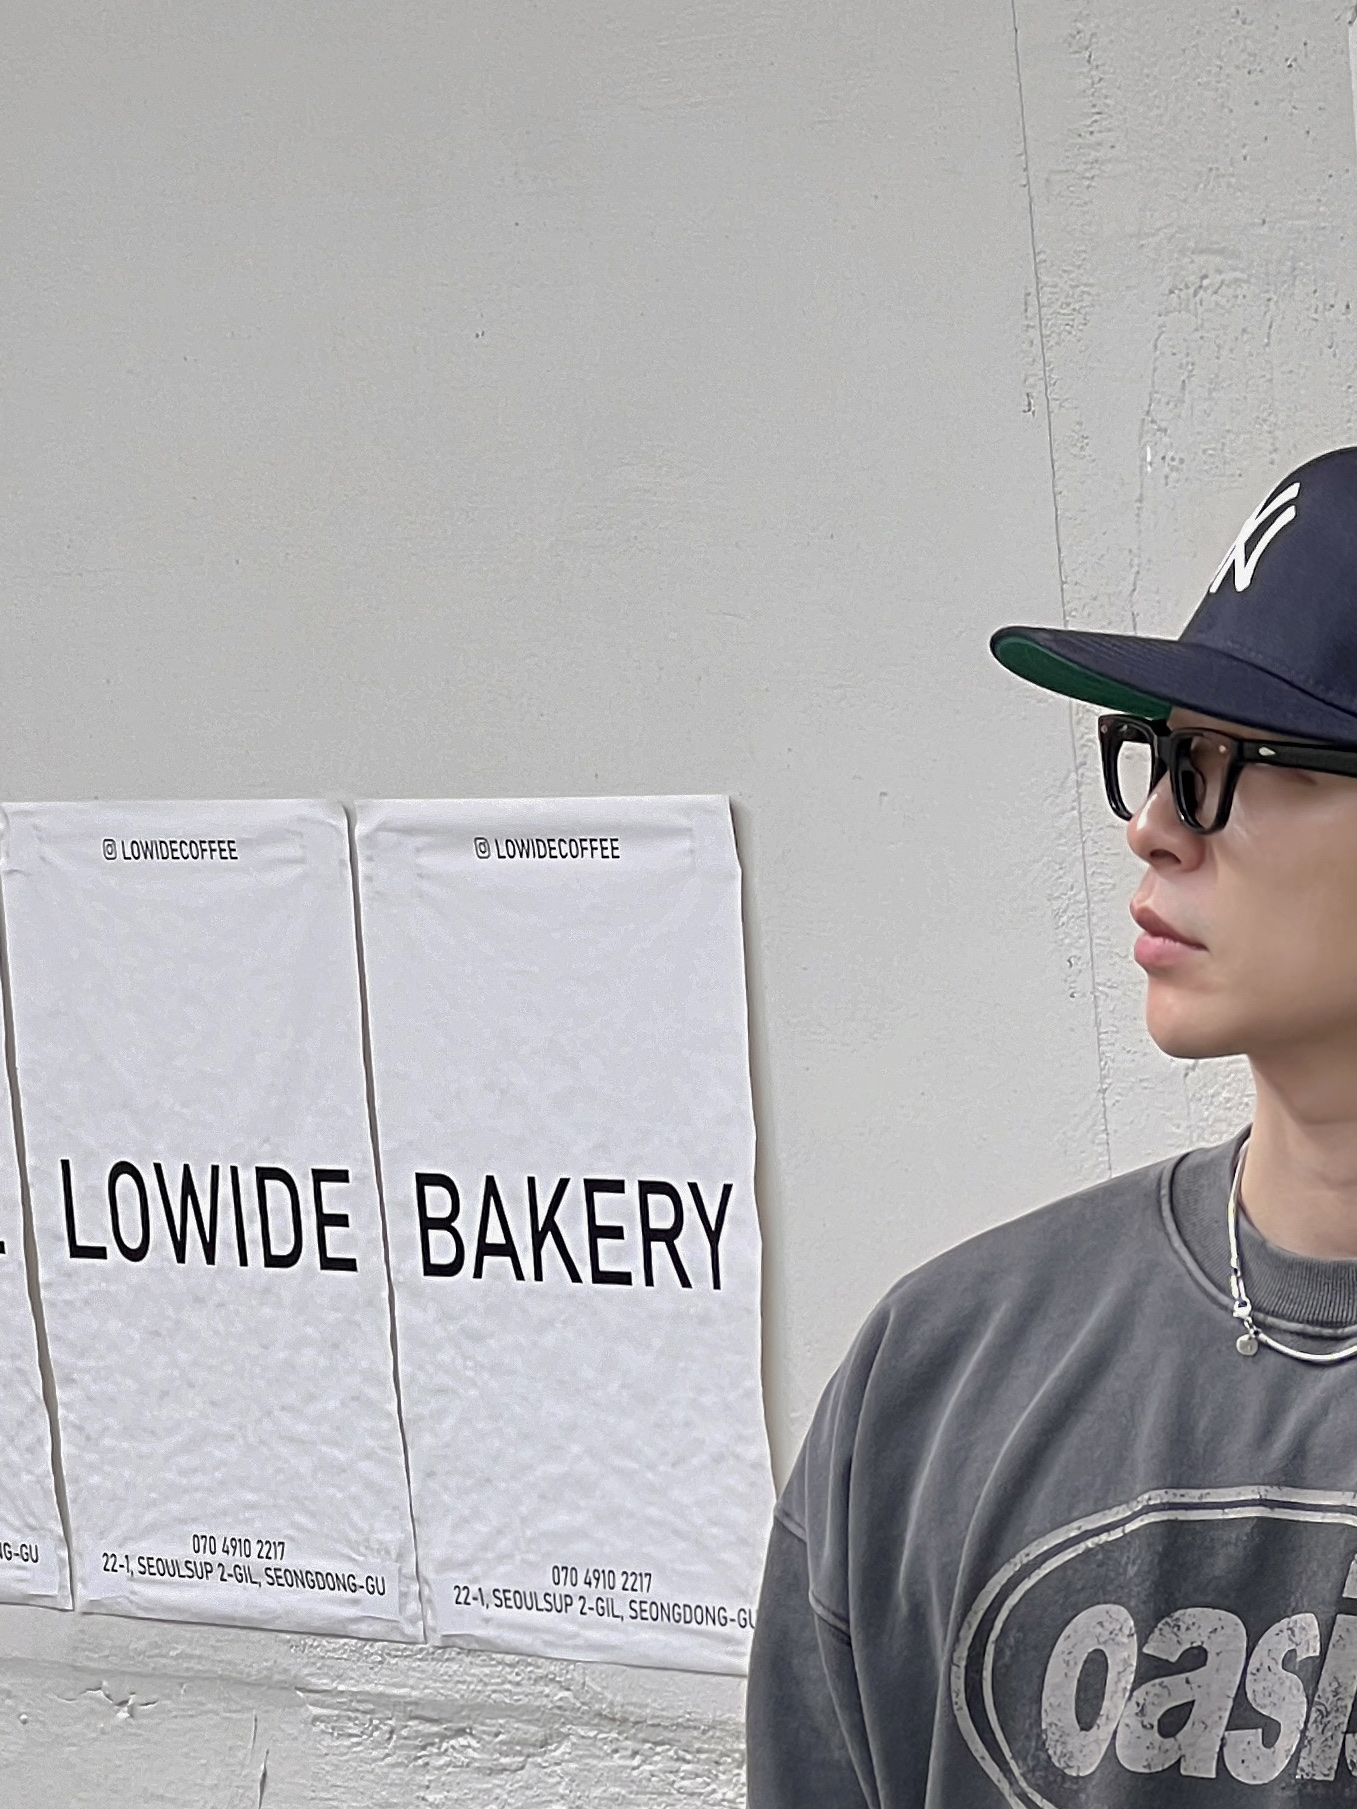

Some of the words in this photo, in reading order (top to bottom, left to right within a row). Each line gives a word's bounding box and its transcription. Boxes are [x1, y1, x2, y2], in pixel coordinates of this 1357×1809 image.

[121, 840, 239, 860] LOWIDECOFFEE
[495, 838, 621, 859] LOWIDECOFFEE
[60, 1158, 359, 1273] LOWIDE
[414, 1172, 734, 1291] BAKERY
[192, 1534, 217, 1556] 070
[221, 1536, 251, 1558] 4910
[256, 1539, 286, 1561] 2217
[102, 1552, 134, 1578] 22-1,
[137, 1555, 213, 1580] SEOULSUP
[218, 1562, 262, 1588] 2-GIL,
[264, 1566, 387, 1596] SEONGDONG-GU
[551, 1565, 578, 1588] 070
[583, 1568, 616, 1590] 4910
[621, 1570, 652, 1593] 2217
[453, 1585, 489, 1610] 22-1,
[493, 1588, 573, 1614] SEOULSUP
[579, 1595, 625, 1622] 2-GIL,
